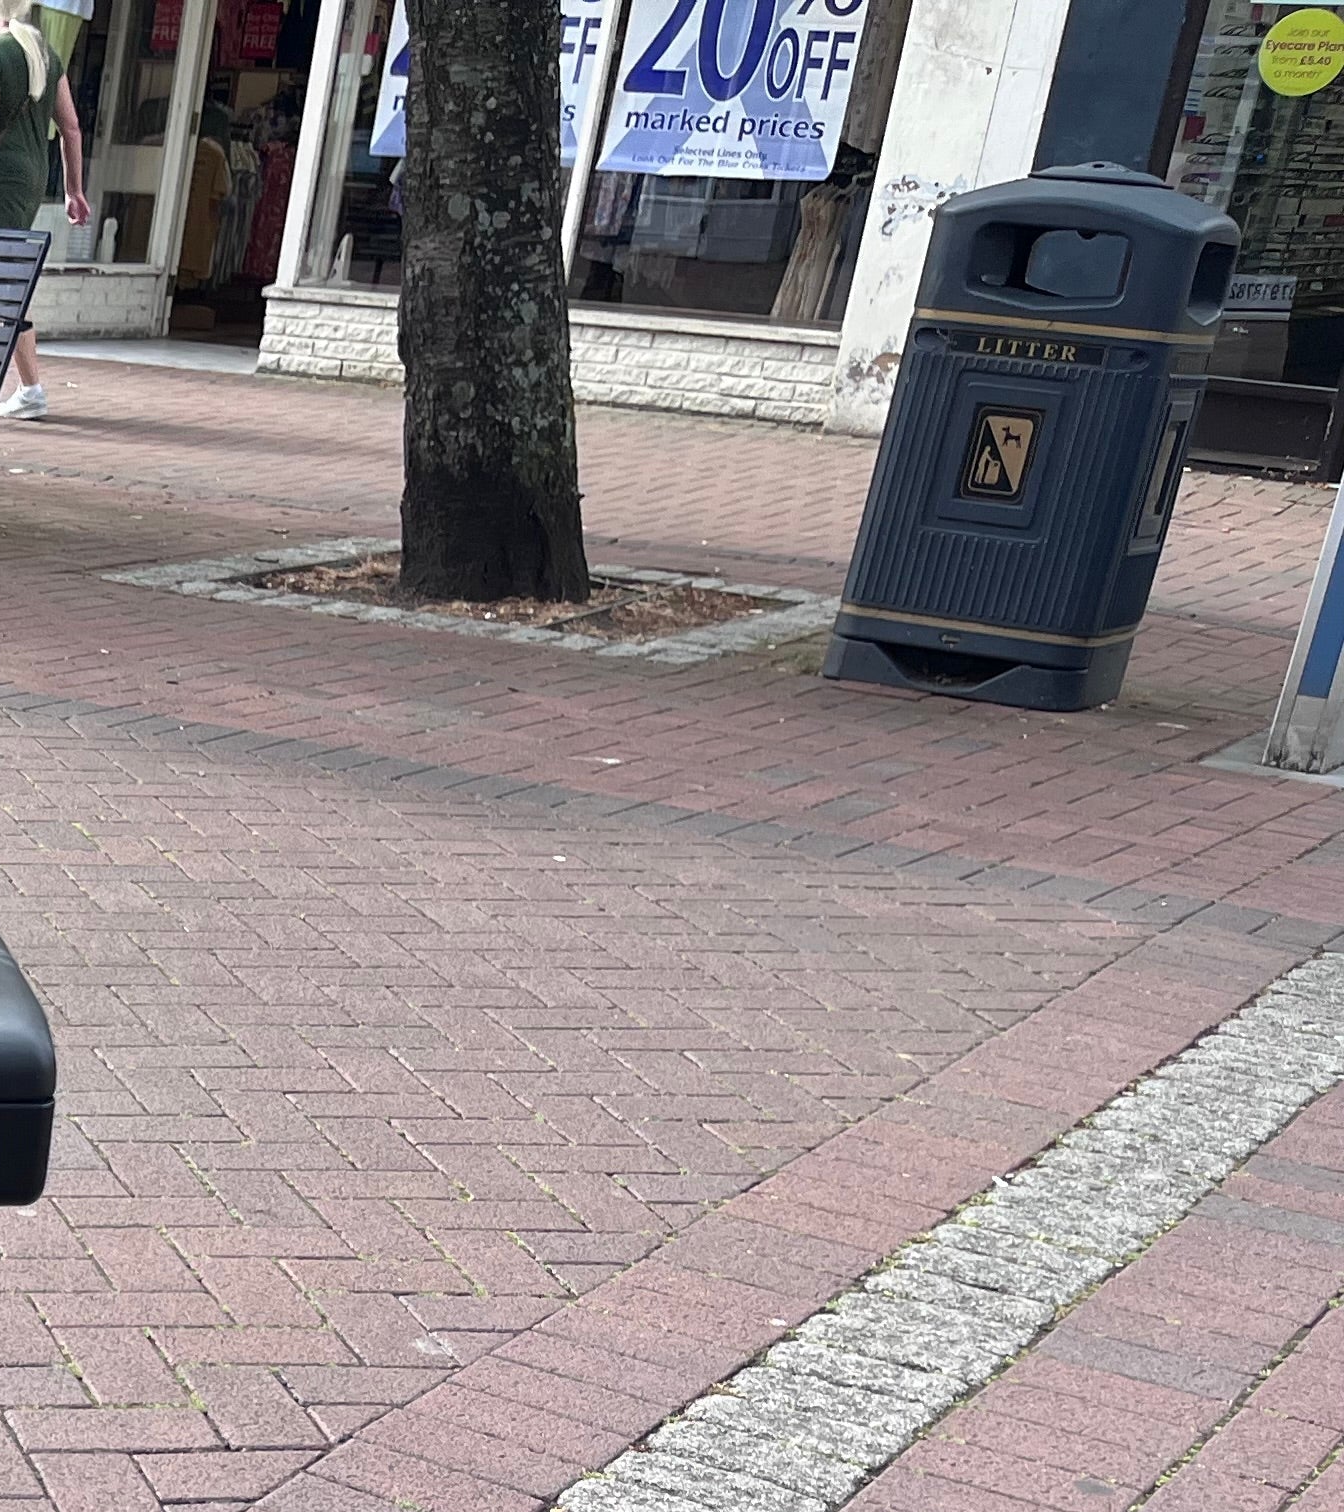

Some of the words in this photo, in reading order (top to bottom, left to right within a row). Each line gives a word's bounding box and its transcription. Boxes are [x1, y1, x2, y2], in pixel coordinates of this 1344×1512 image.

[152, 25, 179, 41] FRE
[1265, 39, 1316, 53] Eyecare
[766, 28, 856, 101] OFF
[625, 108, 730, 134] marked
[737, 112, 826, 142] prices
[674, 146, 715, 157] Selected
[716, 148, 741, 159] Lines
[744, 150, 768, 161] Only
[678, 156, 695, 166] For
[698, 157, 716, 167] The
[717, 158, 739, 168] Blue
[742, 160, 769, 170] Cross
[772, 162, 806, 173] Tickets
[975, 336, 1077, 361] LITTER
